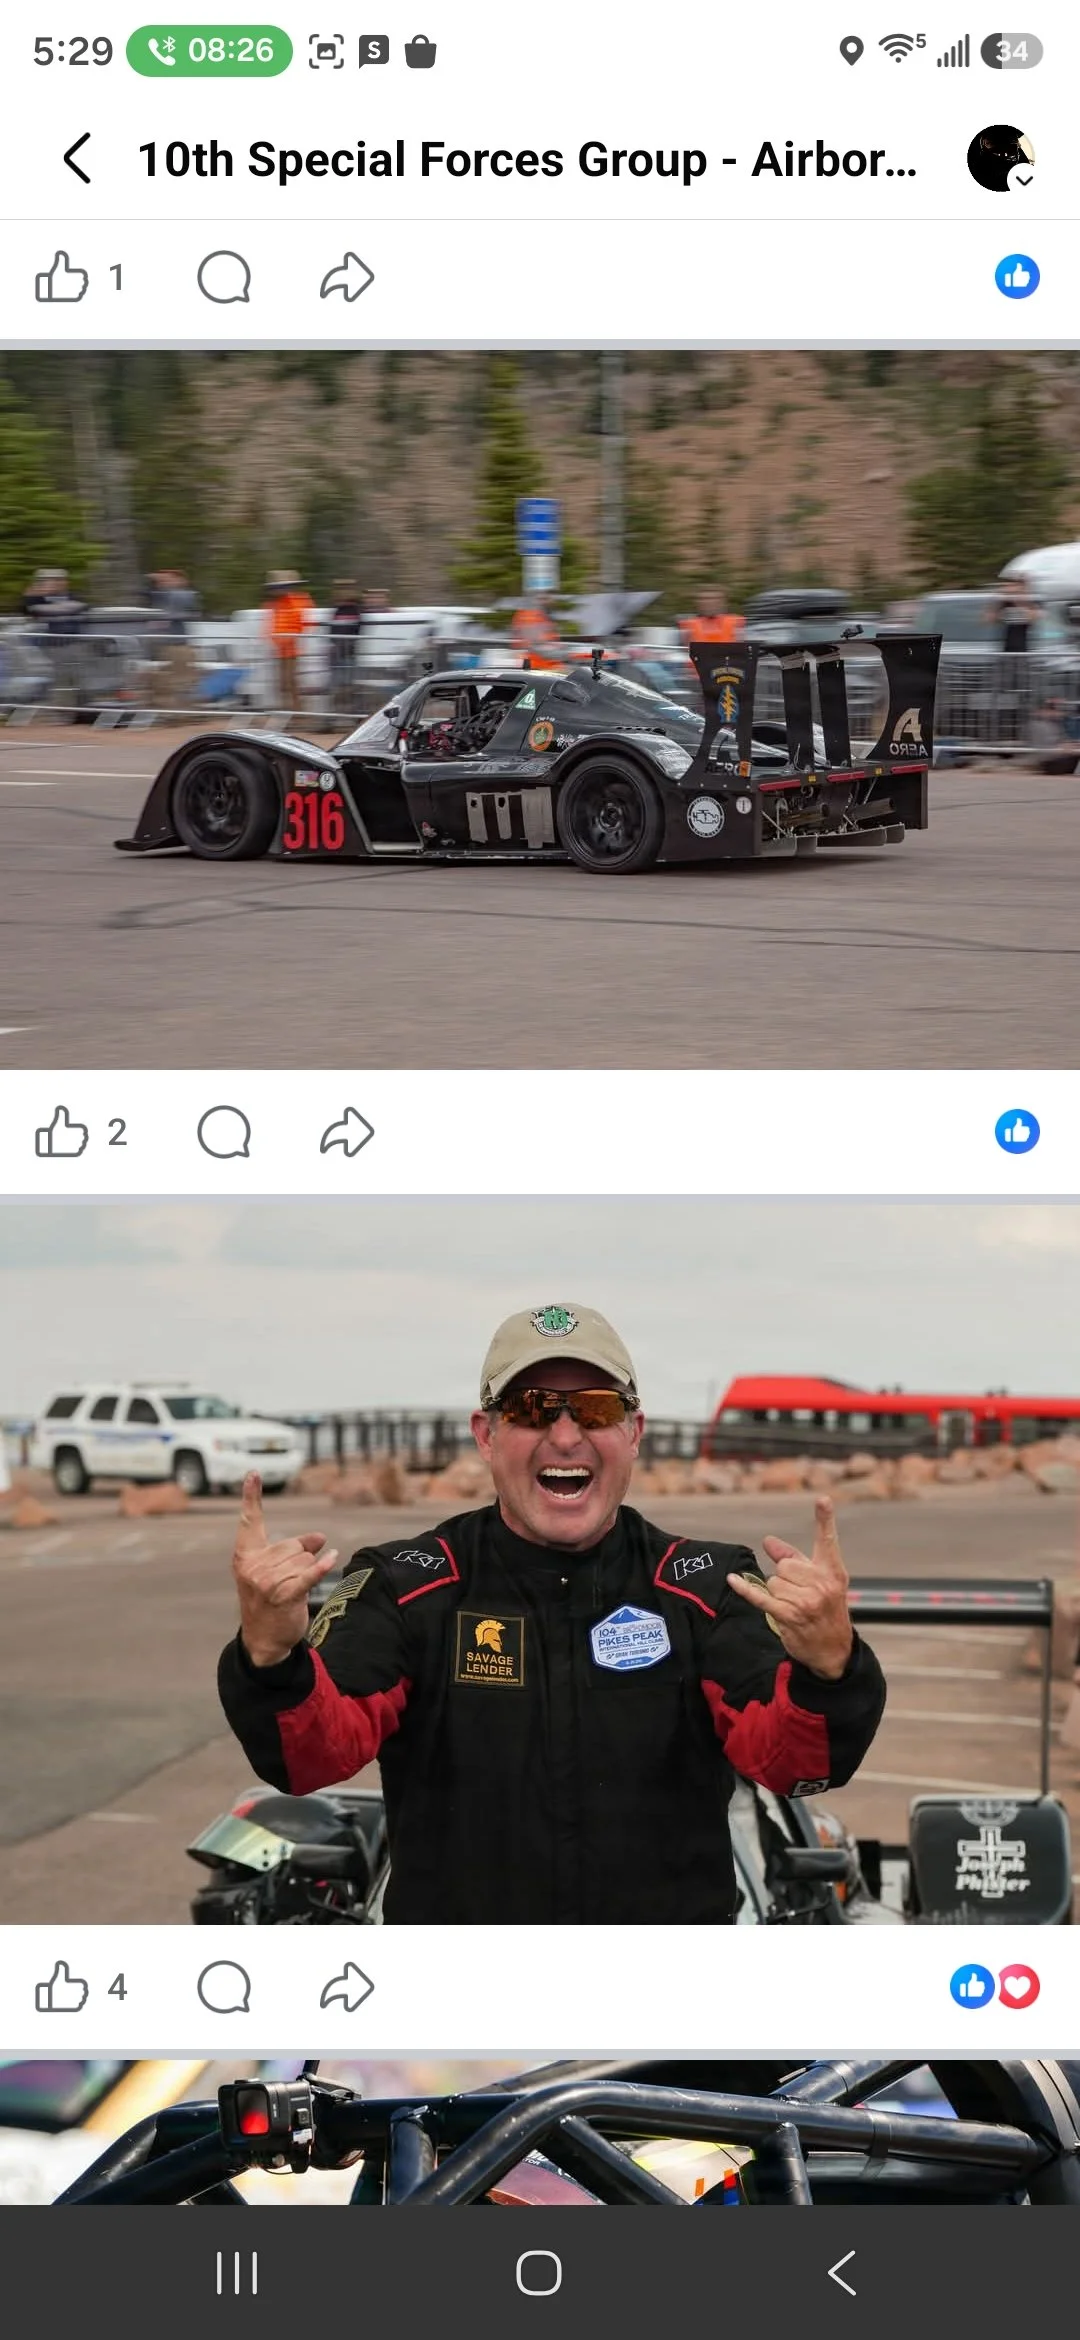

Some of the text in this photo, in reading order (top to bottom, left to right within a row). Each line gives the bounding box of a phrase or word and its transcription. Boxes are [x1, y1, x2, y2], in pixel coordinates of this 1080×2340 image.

[33, 36, 113, 66] 5:29
[188, 37, 274, 62] 08:26
[367, 40, 382, 60] S
[915, 33, 927, 49] 5
[995, 40, 1029, 62] 34
[139, 140, 233, 177] 10th
[248, 140, 405, 187] Special
[421, 141, 564, 177] Forces
[578, 141, 707, 187] Group
[109, 263, 122, 291] 1
[282, 790, 346, 850] 316
[108, 1117, 128, 1146] 2
[673, 1552, 714, 1581] K1
[598, 1629, 663, 1648] PIKES PEAK
[466, 1651, 514, 1666] SAVAGE
[466, 1662, 513, 1676] LENDER
[955, 1856, 1026, 1878] Joseph
[107, 1973, 128, 2001] 4
